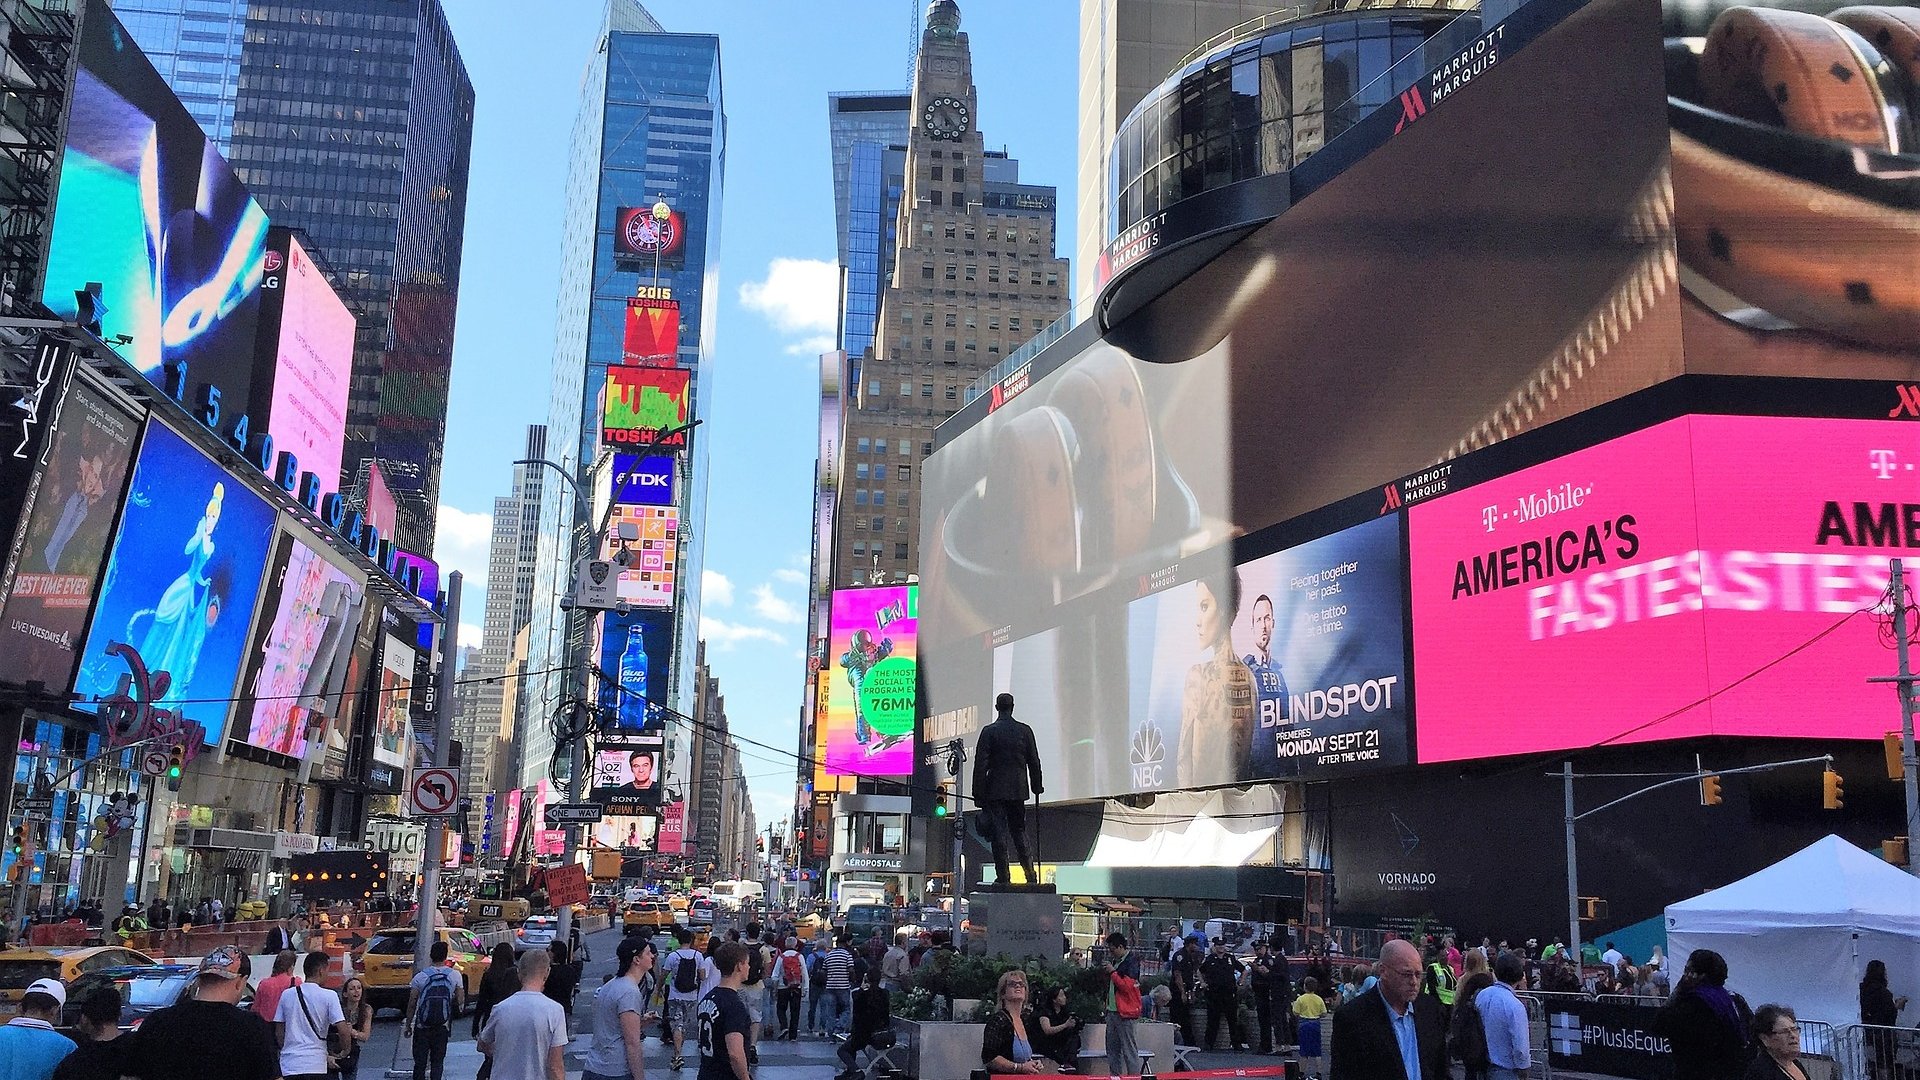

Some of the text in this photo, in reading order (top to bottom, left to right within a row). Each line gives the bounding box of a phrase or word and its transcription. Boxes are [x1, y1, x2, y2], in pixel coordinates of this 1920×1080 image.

[1432, 24, 1506, 86] MARRIOTT
[1432, 50, 1497, 104] MARQUIS
[1112, 212, 1167, 256] MARRIOTT
[1112, 233, 1159, 272] MARQUIS
[637, 286, 672, 300] 2015
[628, 298, 679, 310] TOSHIBA
[1003, 362, 1032, 389] MARRIOTT
[1003, 377, 1029, 400] MARQUIS
[631, 472, 669, 487] TDK
[1404, 465, 1452, 490] MARRIOTT
[1405, 480, 1447, 503] MARQUIS
[283, 451, 425, 597] BROADWAY
[1451, 513, 1640, 600] AMERICA'S
[1150, 563, 1179, 580] MARRIOTT
[1290, 561, 1359, 590] Piecing together
[13, 575, 89, 595] BEST TIME EVER
[1150, 575, 1176, 590] MARQUIS
[1305, 581, 1342, 601] her past.
[1320, 604, 1347, 621] tattoo
[11, 619, 28, 633] LIVE!
[28, 624, 60, 644] TUESDAYS
[1322, 619, 1344, 634] time.
[892, 669, 916, 677] MOST
[1261, 672, 1281, 686] FBI
[864, 686, 905, 694] PROGRAM
[874, 678, 904, 686] SOCIAL
[871, 698, 916, 712] 76MM
[1260, 675, 1397, 729] BLINDSPOT
[923, 705, 978, 744] WALKING DEAD
[1275, 728, 1312, 742] PREMIERES
[1277, 729, 1379, 759] MONDAY SEPT 21
[1317, 749, 1380, 766] AFTER THE VOICE
[604, 763, 620, 772] OZ
[1132, 764, 1163, 789] NBC
[551, 809, 598, 817] ONE WAY
[606, 804, 633, 814] AFGHAN
[667, 824, 682, 832] U.S.
[843, 857, 902, 868] AÉROPOSTALE
[1378, 873, 1436, 885] VORNADO
[482, 906, 499, 916] CAT
[1582, 1024, 1673, 1056] #PlusIsEqua
